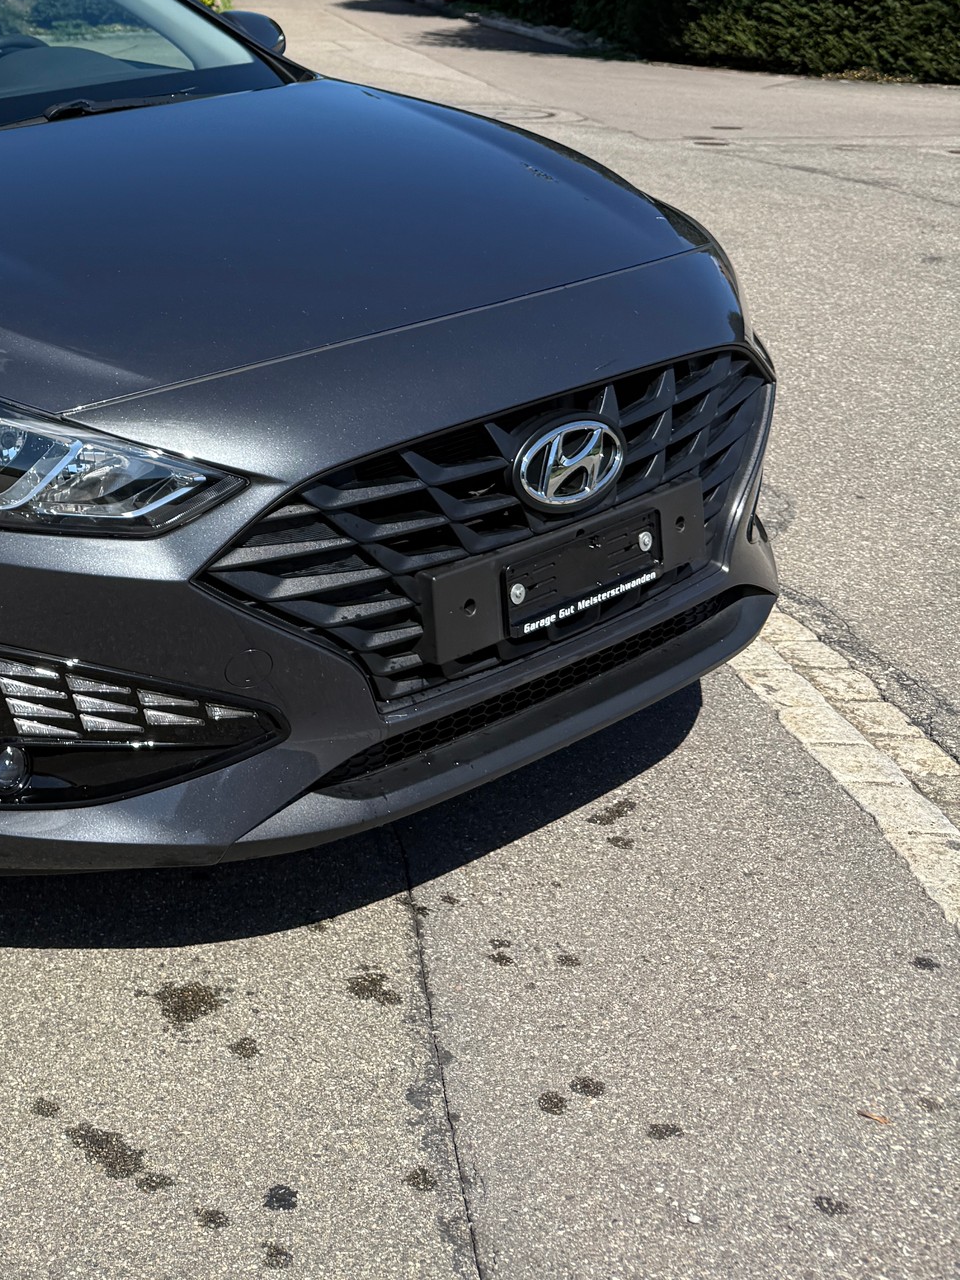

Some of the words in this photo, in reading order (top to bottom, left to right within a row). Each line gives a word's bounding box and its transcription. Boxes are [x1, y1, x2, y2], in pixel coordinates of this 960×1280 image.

[523, 614, 557, 634] Garage
[558, 605, 575, 619] Gut
[577, 571, 657, 611] Meisterschwanden
